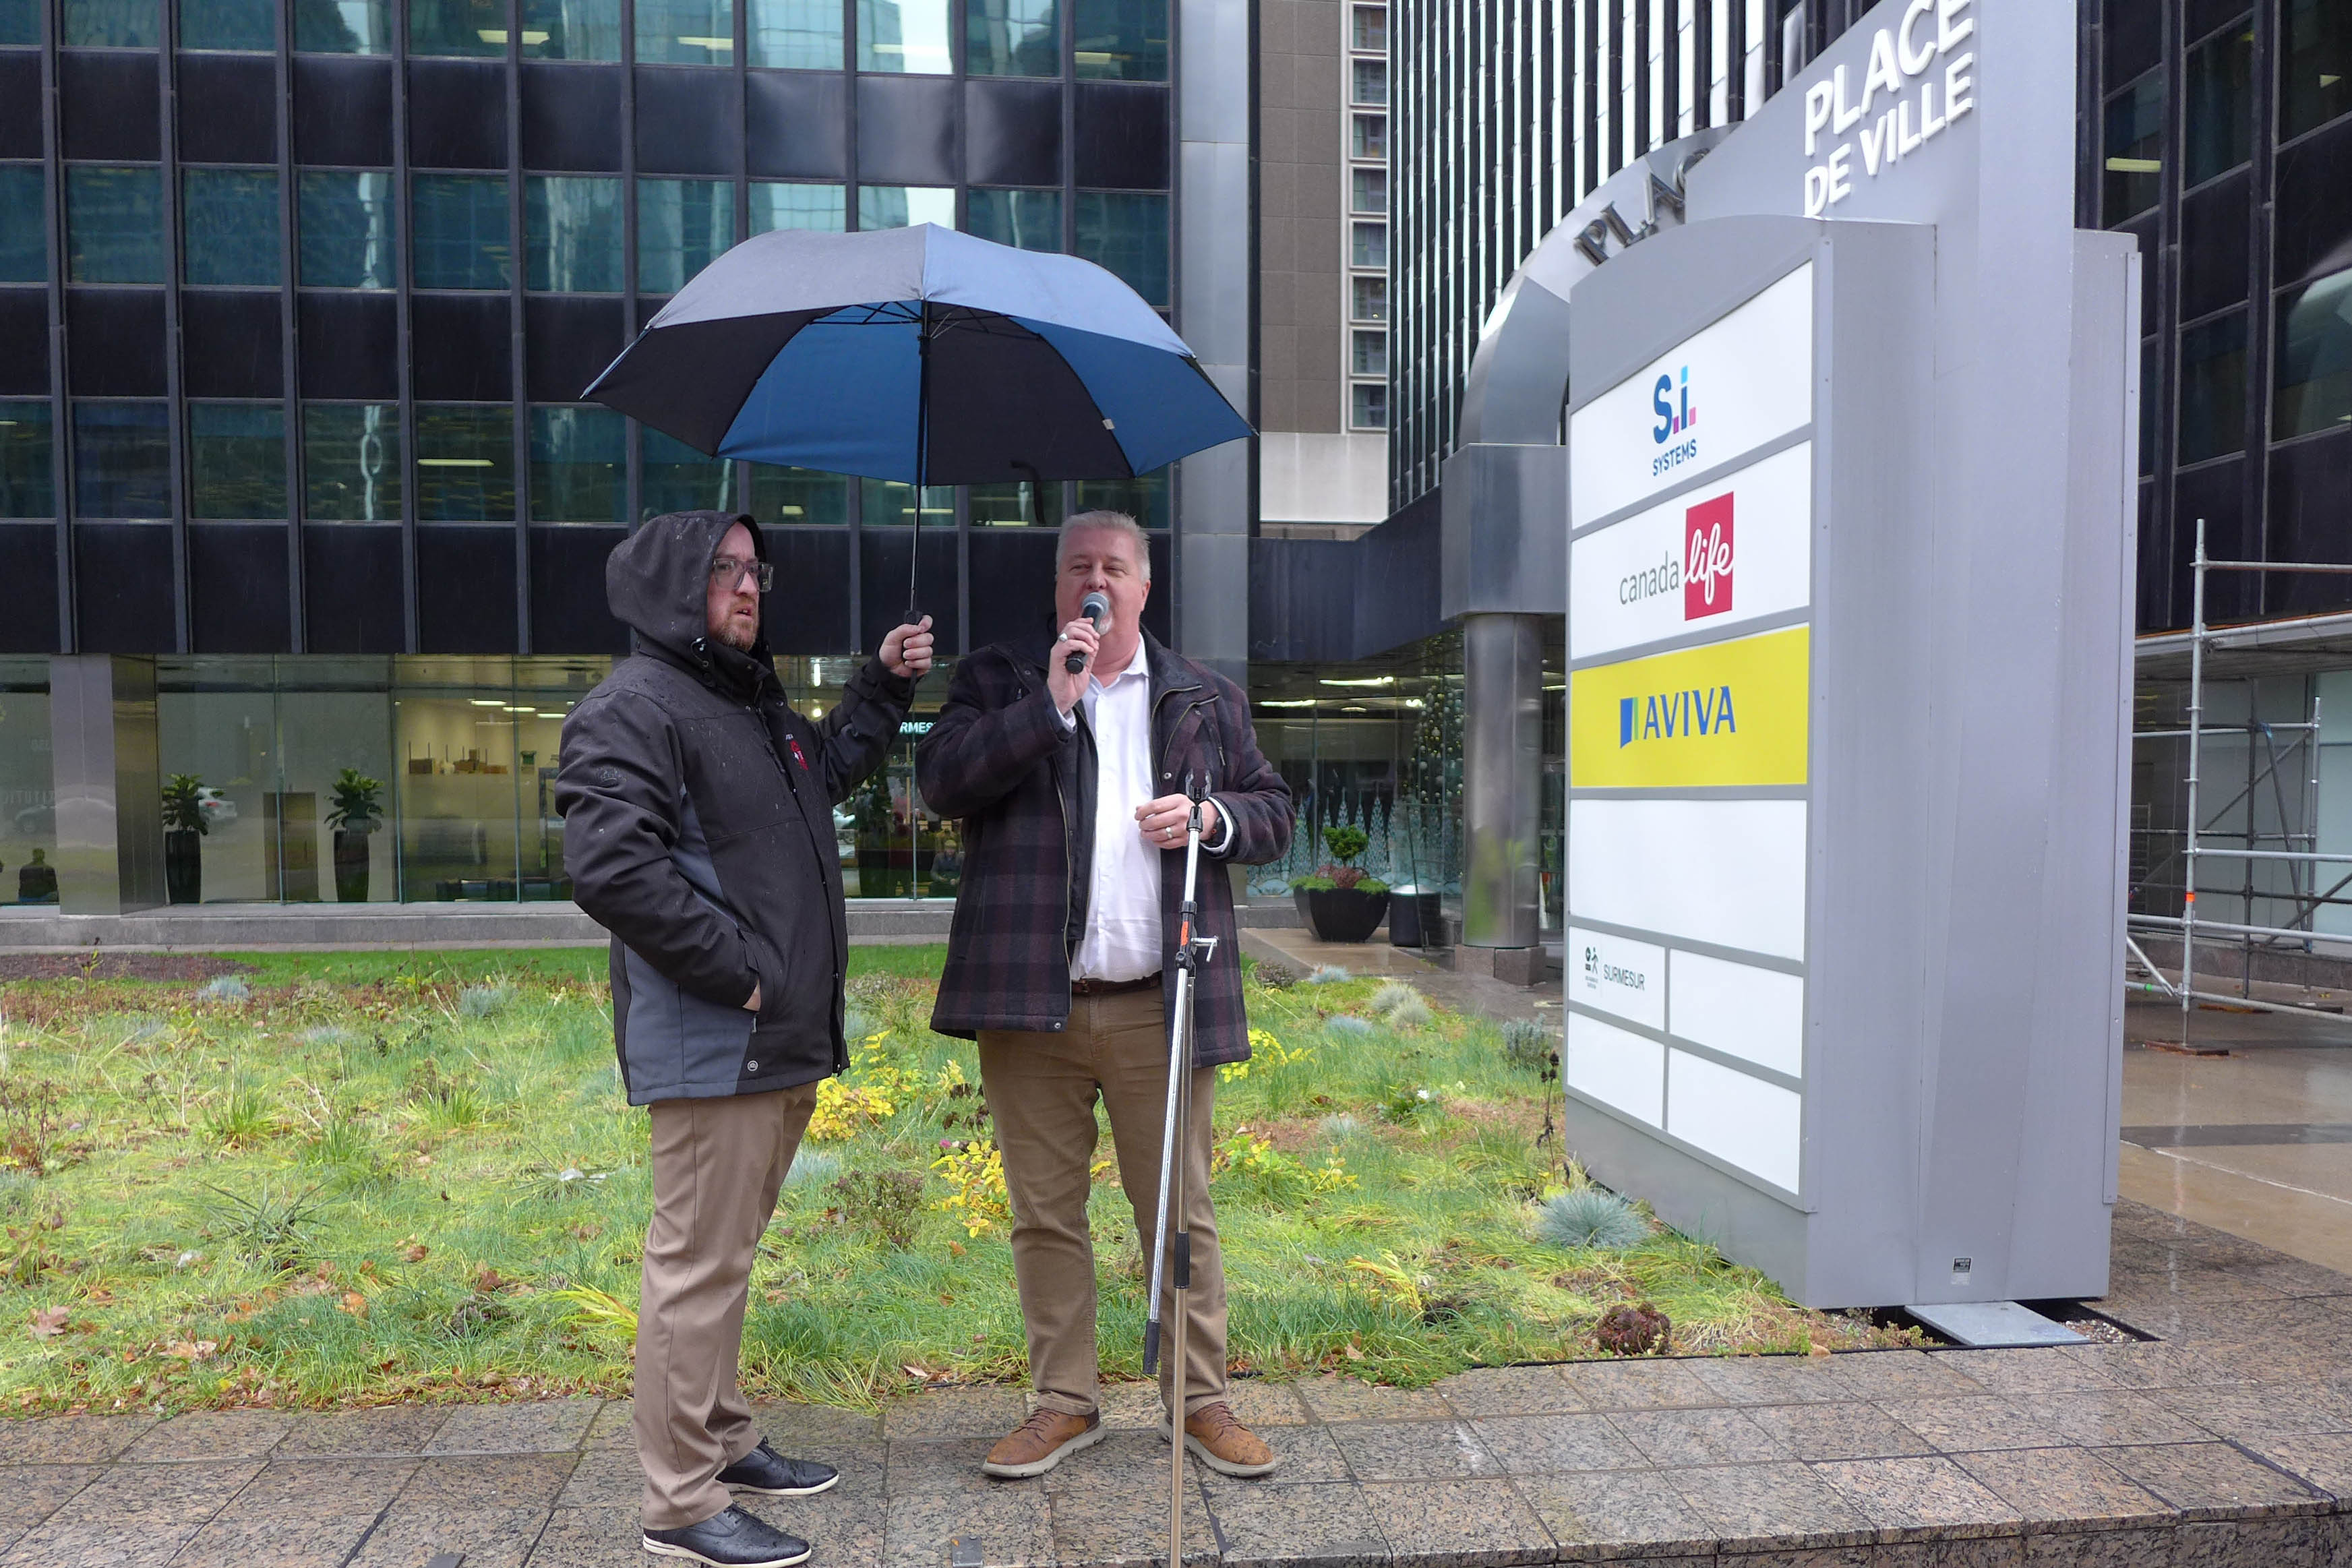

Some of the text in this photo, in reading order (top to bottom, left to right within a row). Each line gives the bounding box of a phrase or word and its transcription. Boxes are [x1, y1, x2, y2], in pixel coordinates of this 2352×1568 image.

[1805, 0, 1974, 156] PLACE
[1804, 52, 1974, 217] DE VILLE
[1652, 438, 1697, 476] SYSTEMS
[1619, 522, 1734, 605] canada life
[1643, 685, 1737, 740] AVIVA
[1603, 963, 1646, 992] SURMESUR
